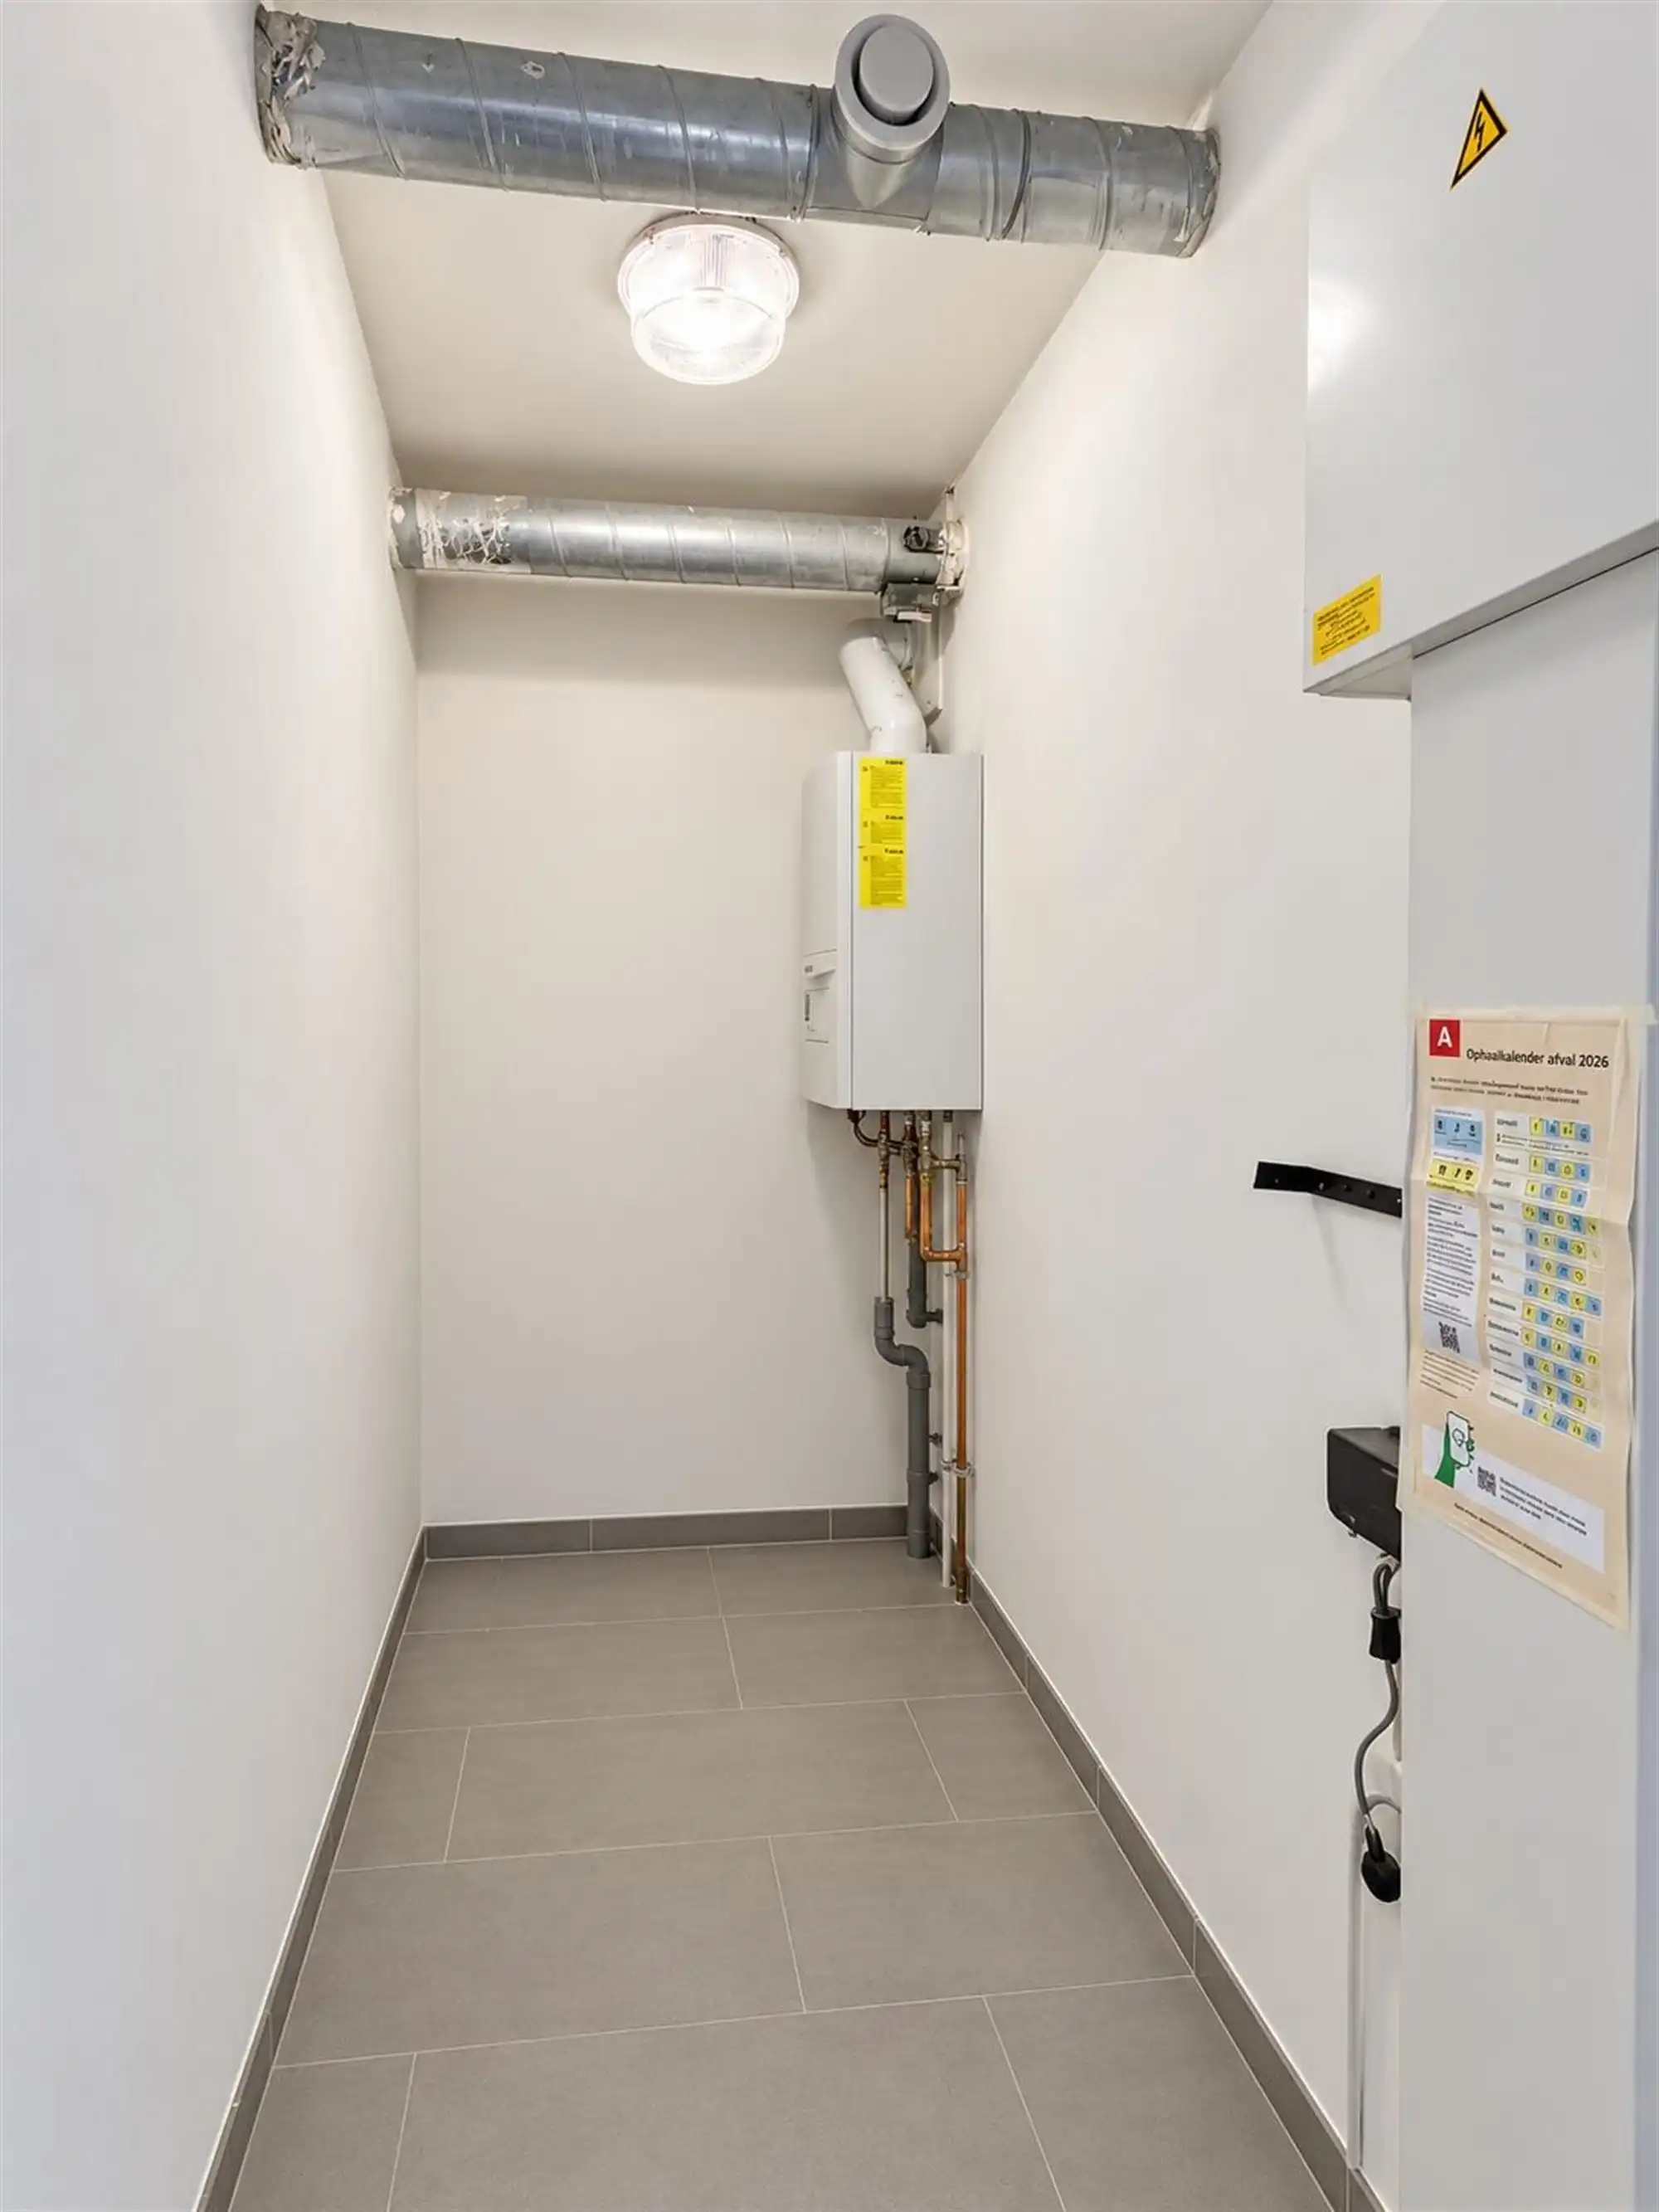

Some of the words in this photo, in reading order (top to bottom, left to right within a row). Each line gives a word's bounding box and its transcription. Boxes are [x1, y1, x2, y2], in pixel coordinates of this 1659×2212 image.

[1436, 1026, 1452, 1048] A
[1466, 1048, 1545, 1064] Ophaalkalender
[1548, 1052, 1576, 1066] afval
[1579, 1054, 1609, 1068] 2026
